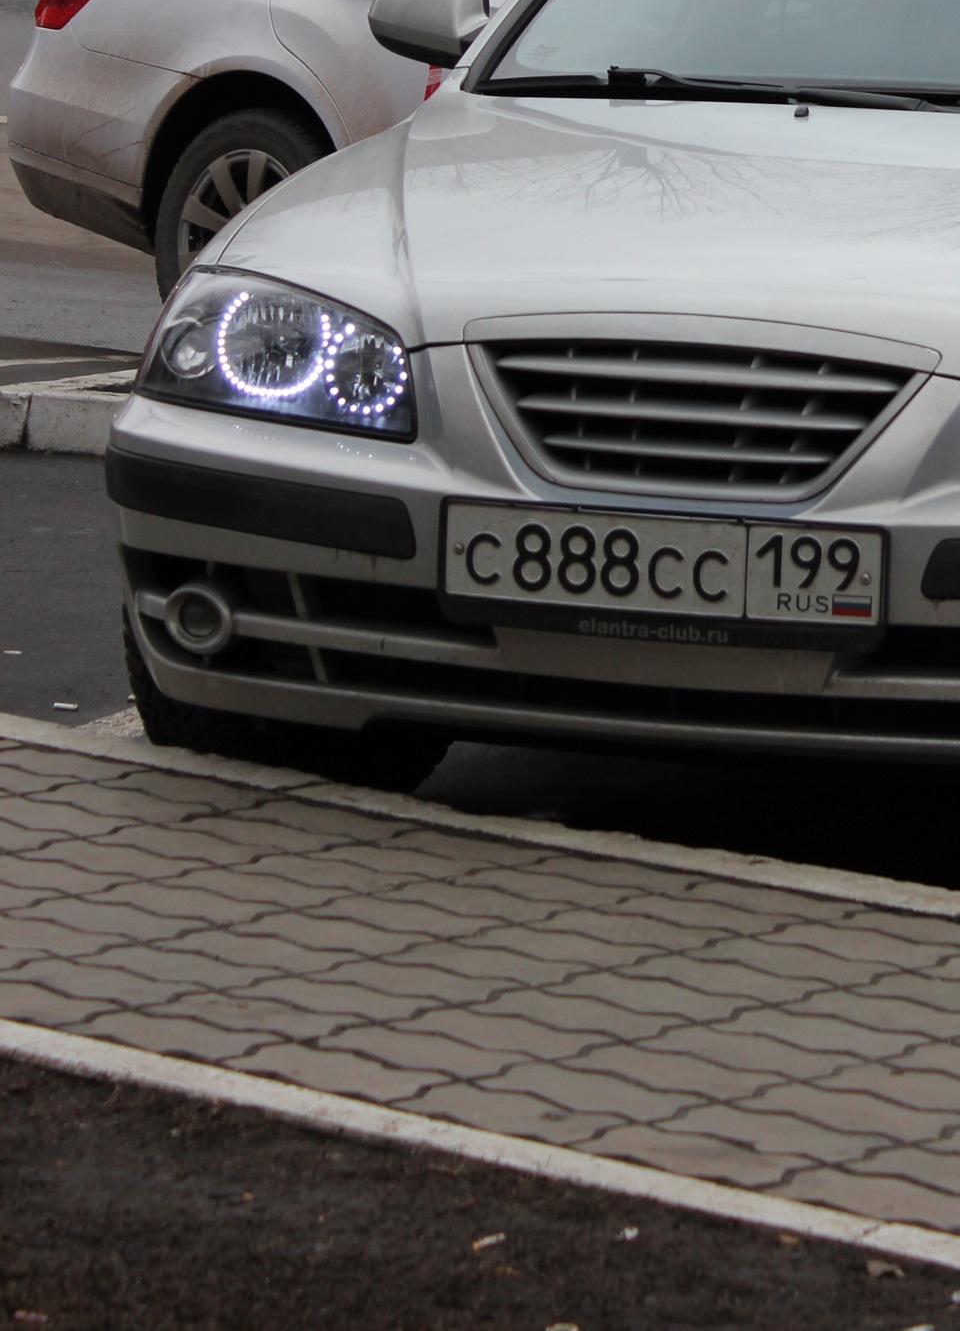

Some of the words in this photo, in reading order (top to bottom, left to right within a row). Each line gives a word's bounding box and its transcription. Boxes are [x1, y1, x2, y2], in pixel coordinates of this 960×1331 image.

[755, 534, 860, 591] 199
[776, 592, 830, 614] RUS
[578, 617, 729, 643] elantra-club.ru
